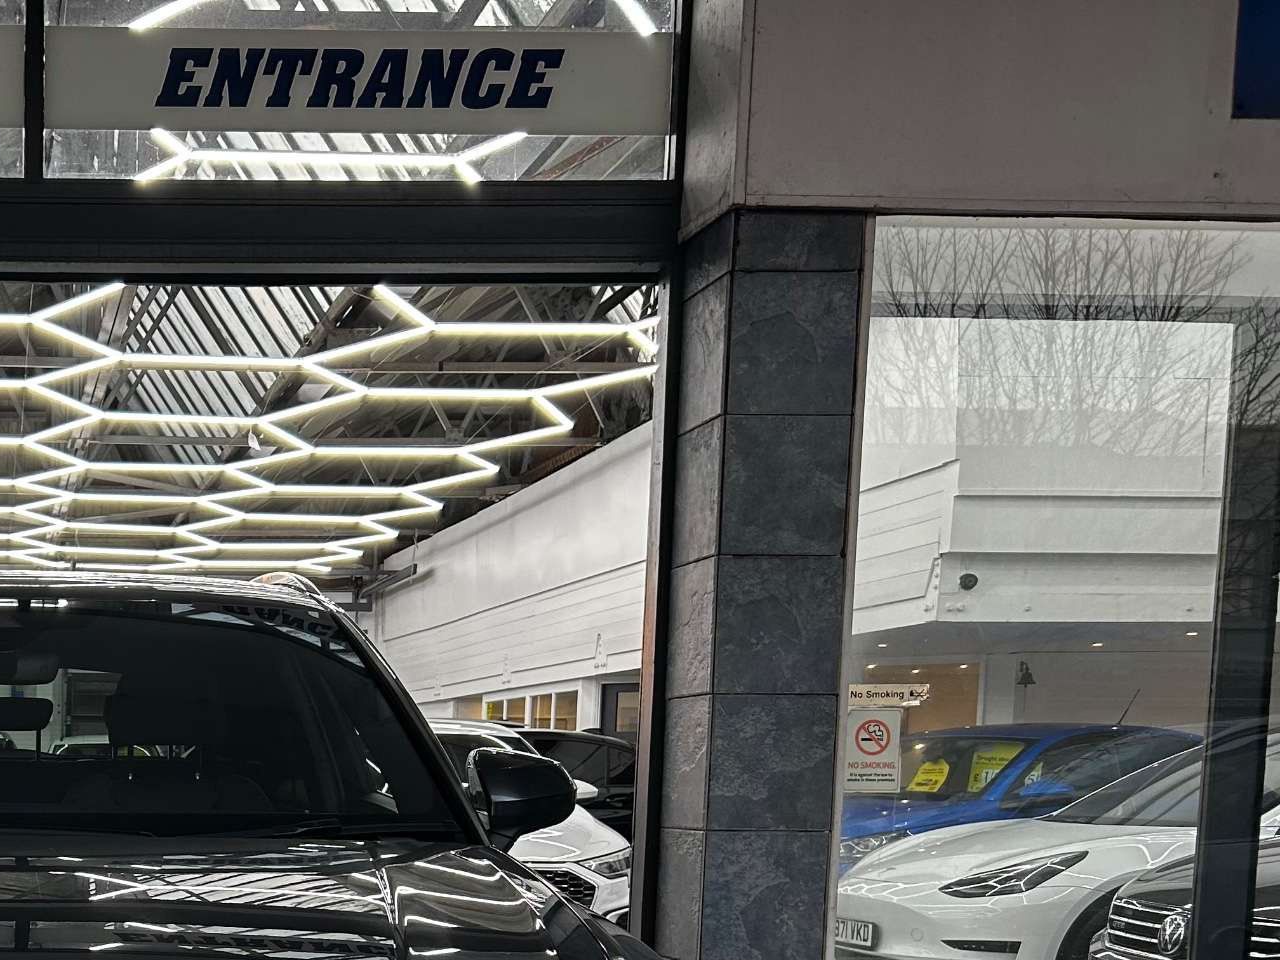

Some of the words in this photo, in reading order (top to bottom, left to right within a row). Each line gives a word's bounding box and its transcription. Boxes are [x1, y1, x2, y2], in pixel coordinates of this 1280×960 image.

[154, 47, 565, 109] ENTRANCE
[850, 690, 863, 699] No
[866, 690, 905, 699] Smoking
